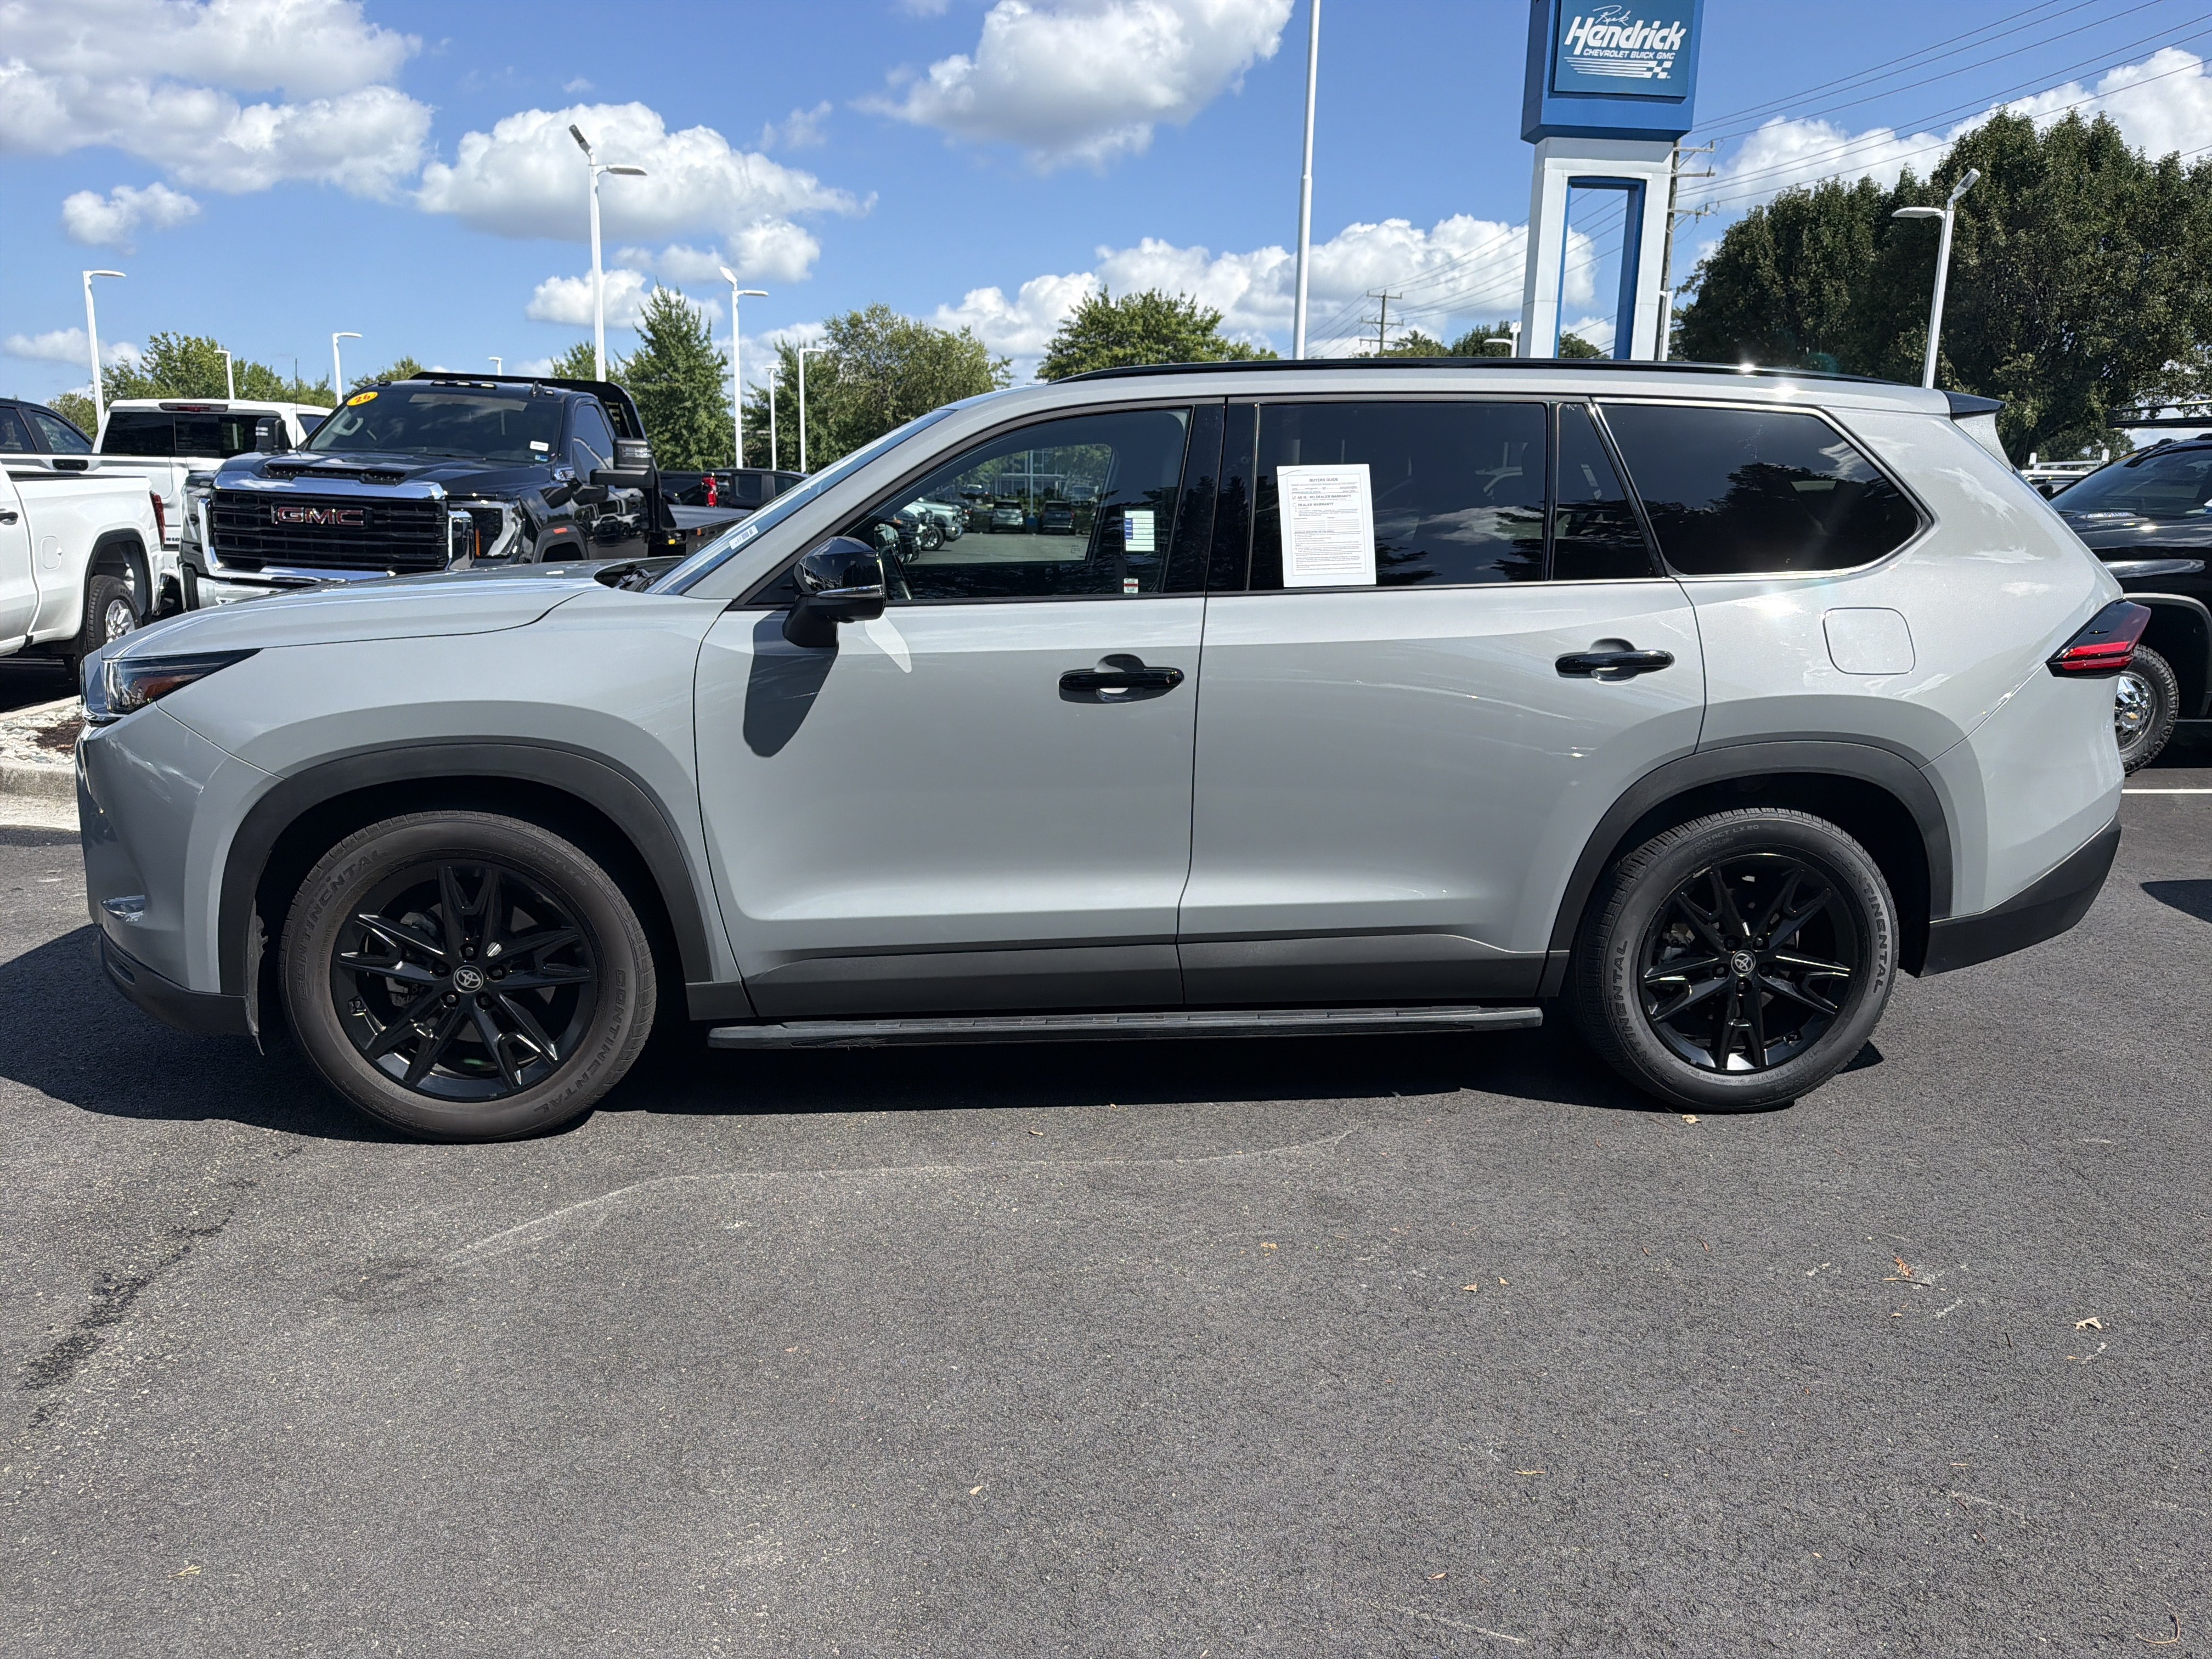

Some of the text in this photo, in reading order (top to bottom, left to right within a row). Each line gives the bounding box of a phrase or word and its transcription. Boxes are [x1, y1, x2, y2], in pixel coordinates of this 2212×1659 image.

[1564, 16, 1687, 55] Hendrick
[1583, 48, 1676, 60] CHEVROLET BUICK GMC
[354, 394, 371, 403] 26
[277, 506, 364, 526] GMC
[296, 850, 386, 1000] CONTINENTAL
[1827, 850, 1888, 994] CONTINENTAL
[534, 969, 627, 1114] CONTINENTAL
[1612, 940, 1676, 1085] CONTINENTAL
